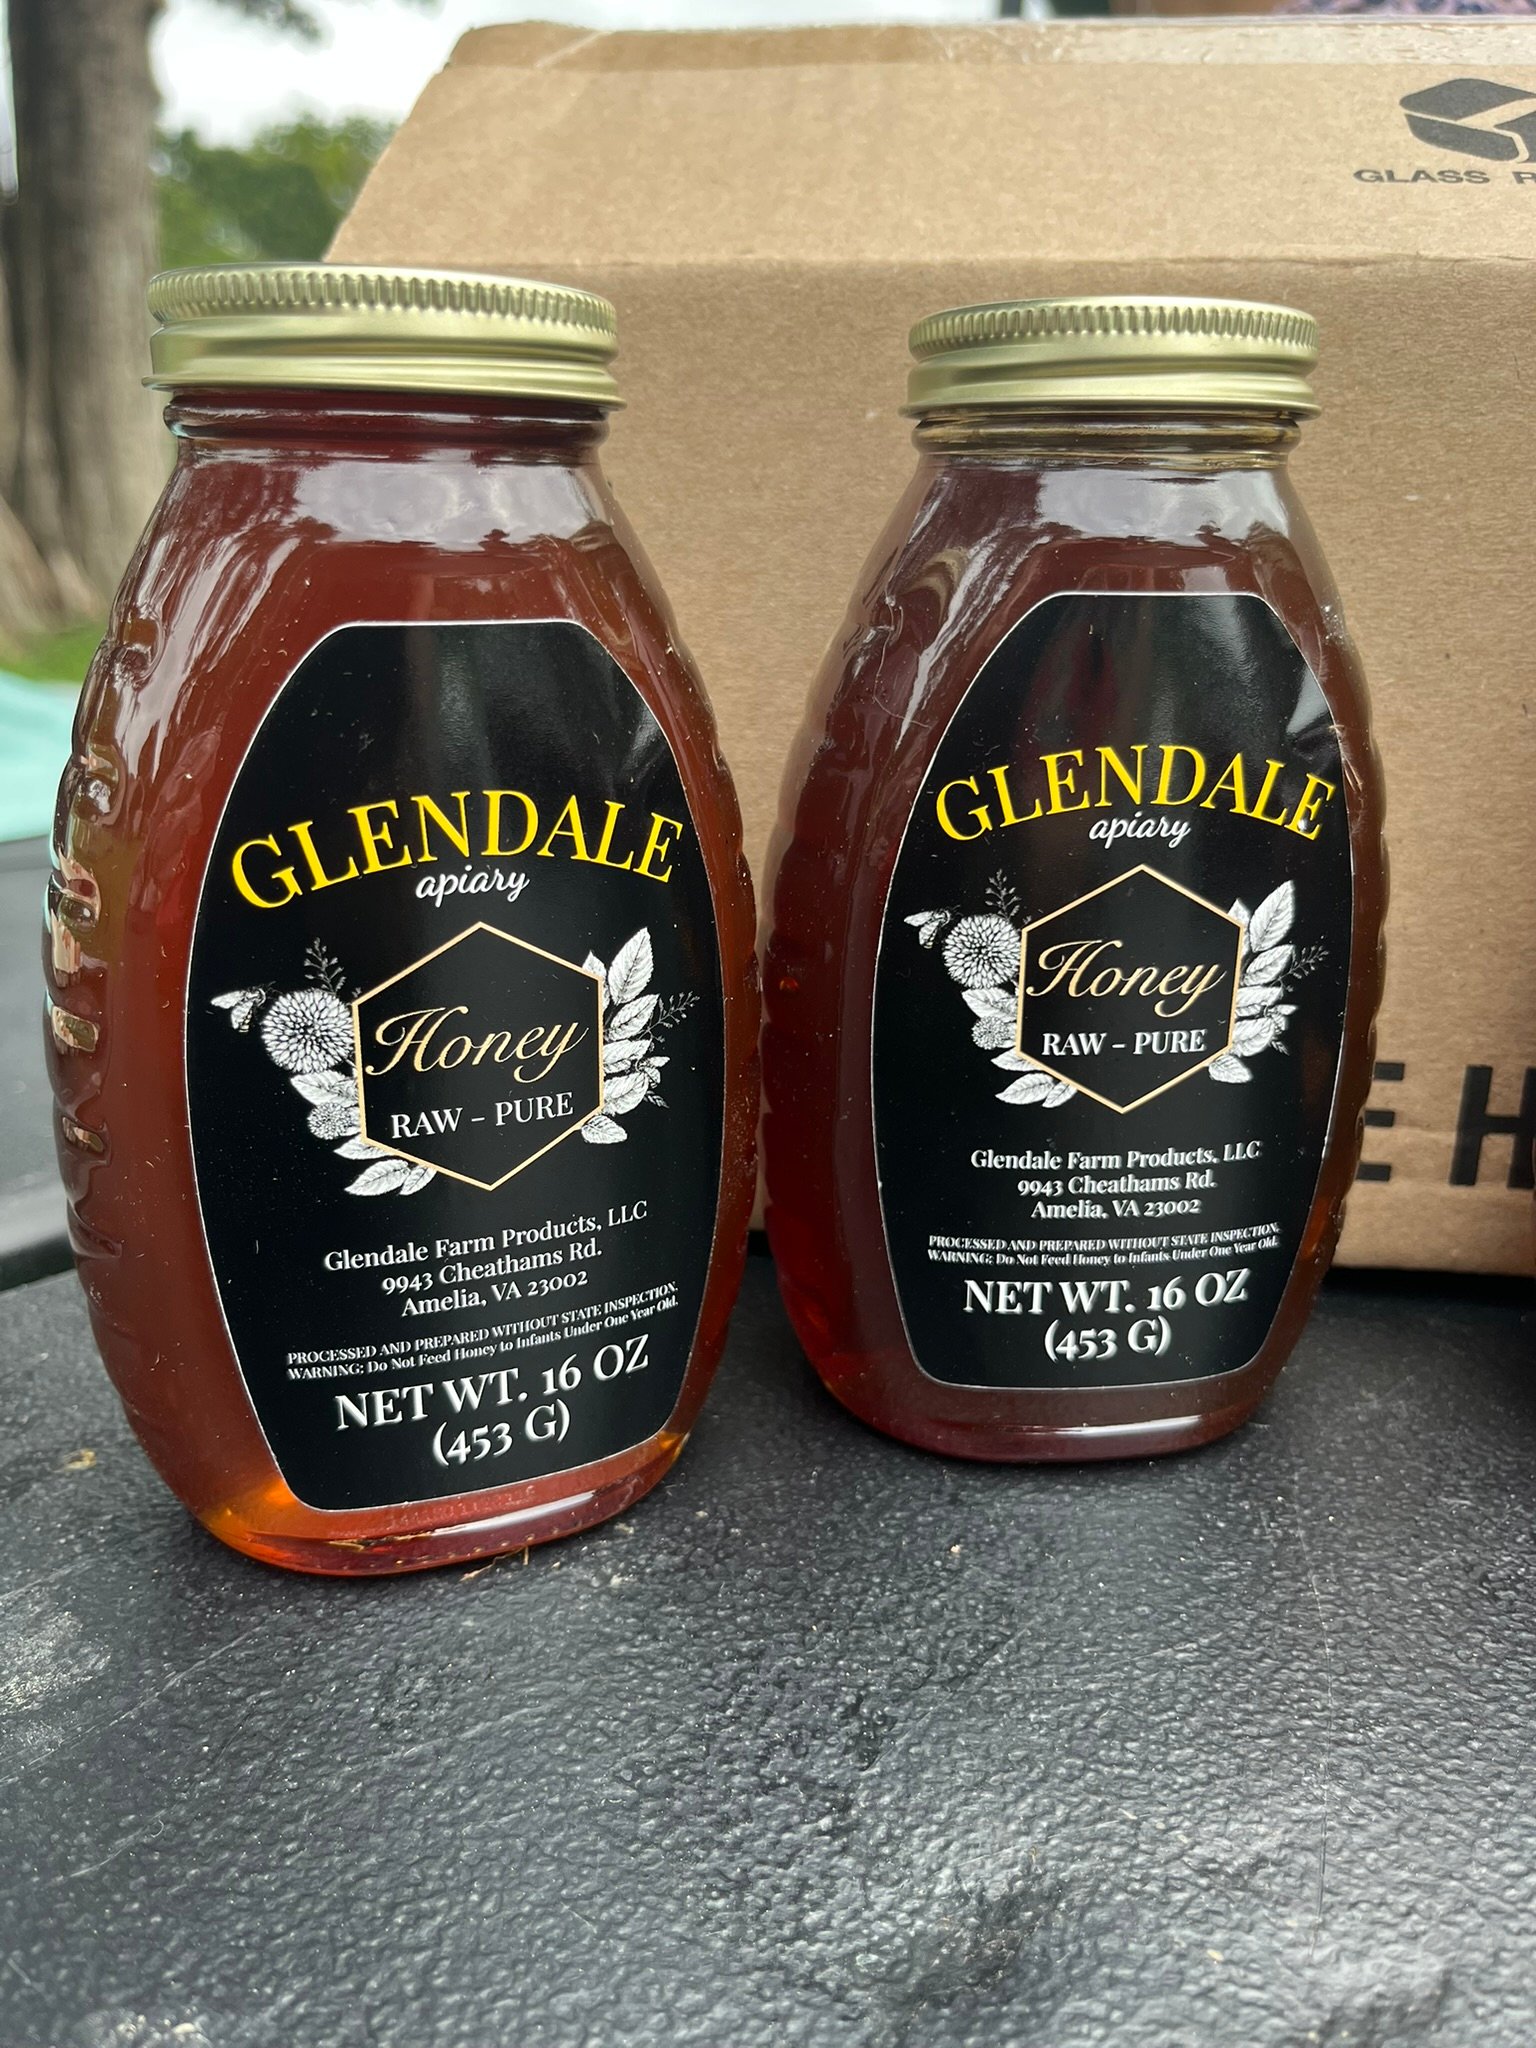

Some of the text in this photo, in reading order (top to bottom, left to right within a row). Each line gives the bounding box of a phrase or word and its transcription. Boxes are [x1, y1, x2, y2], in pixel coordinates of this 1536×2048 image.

[1353, 169, 1490, 184] GLASS
[937, 745, 1335, 840] GLENDALE
[231, 789, 684, 908] GLENDALE
[1088, 811, 1191, 848] apiary
[416, 864, 530, 907] apiary
[1026, 939, 1226, 1018] Honey
[366, 1006, 589, 1084] Honey
[1041, 1032, 1107, 1056] RAW
[1133, 1029, 1207, 1055] PURE
[391, 1107, 463, 1139] RAW
[496, 1092, 574, 1126] PURE
[970, 1140, 1263, 1170] Glendale Farm Products, LLC
[1017, 1169, 1218, 1198] 9943 Cheathams Rd.
[1030, 1198, 1202, 1219] Amelia, VA 23002
[324, 1201, 648, 1271] Glendale Farm Products, LLC
[927, 1249, 994, 1265] WARNING:
[996, 1253, 1015, 1265] Do
[1016, 1254, 1039, 1266] Not
[1040, 1254, 1071, 1266] Feed
[1072, 1254, 1112, 1267] Honey
[1114, 1253, 1126, 1264] to
[1128, 1251, 1171, 1264] Infants
[1172, 1248, 1207, 1260] Under
[1209, 1245, 1232, 1256] One
[1234, 1241, 1256, 1254] Year
[928, 1235, 1007, 1250] PROCESSED
[1007, 1239, 1038, 1251] AND
[1039, 1239, 1105, 1251] PREPARED
[1107, 1236, 1170, 1250] WITHOUT
[1170, 1232, 1209, 1246] STATE
[382, 1238, 602, 1296] 9943 Cheathams Rd.
[963, 1267, 1253, 1314] NET WT. 16 OZ
[401, 1271, 588, 1317] Amelia, VA 23002
[287, 1281, 679, 1365] PROCESSED AND PREPARED WITHOUT STATE INSPECTION.
[287, 1295, 679, 1380] WARNING: Do Not Feed Honey to Infants Under One Year Old.
[1043, 1314, 1172, 1363] (453 G)
[335, 1334, 649, 1431] NET WT. 16 OZ
[432, 1399, 571, 1466] (453 G)
